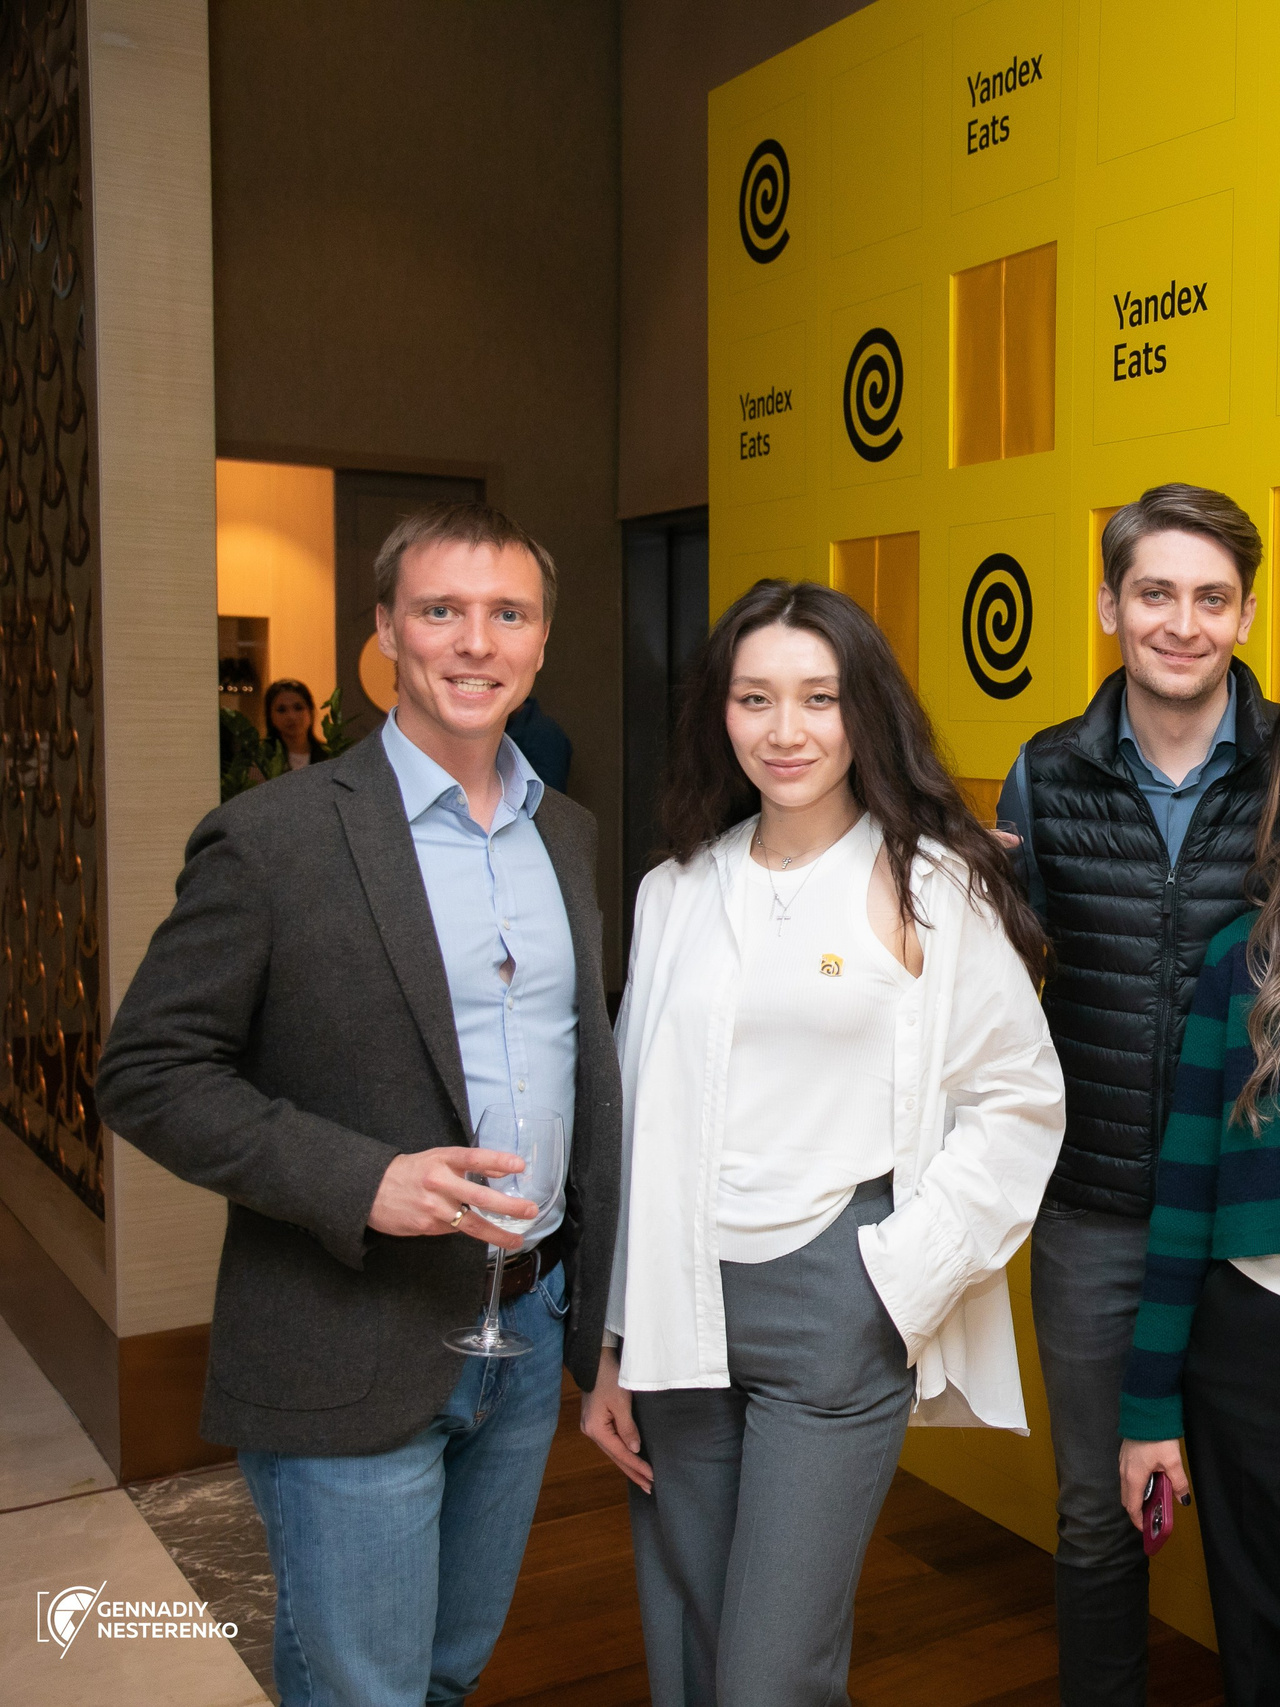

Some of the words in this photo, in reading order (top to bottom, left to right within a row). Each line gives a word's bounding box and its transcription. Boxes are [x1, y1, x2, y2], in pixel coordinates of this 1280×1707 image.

[967, 53, 1043, 108] Yandex
[967, 114, 1010, 156] Eats
[1113, 280, 1208, 331] Yandex
[1113, 342, 1167, 382] Eats
[739, 385, 793, 422] Yandex
[739, 431, 771, 461] Eats
